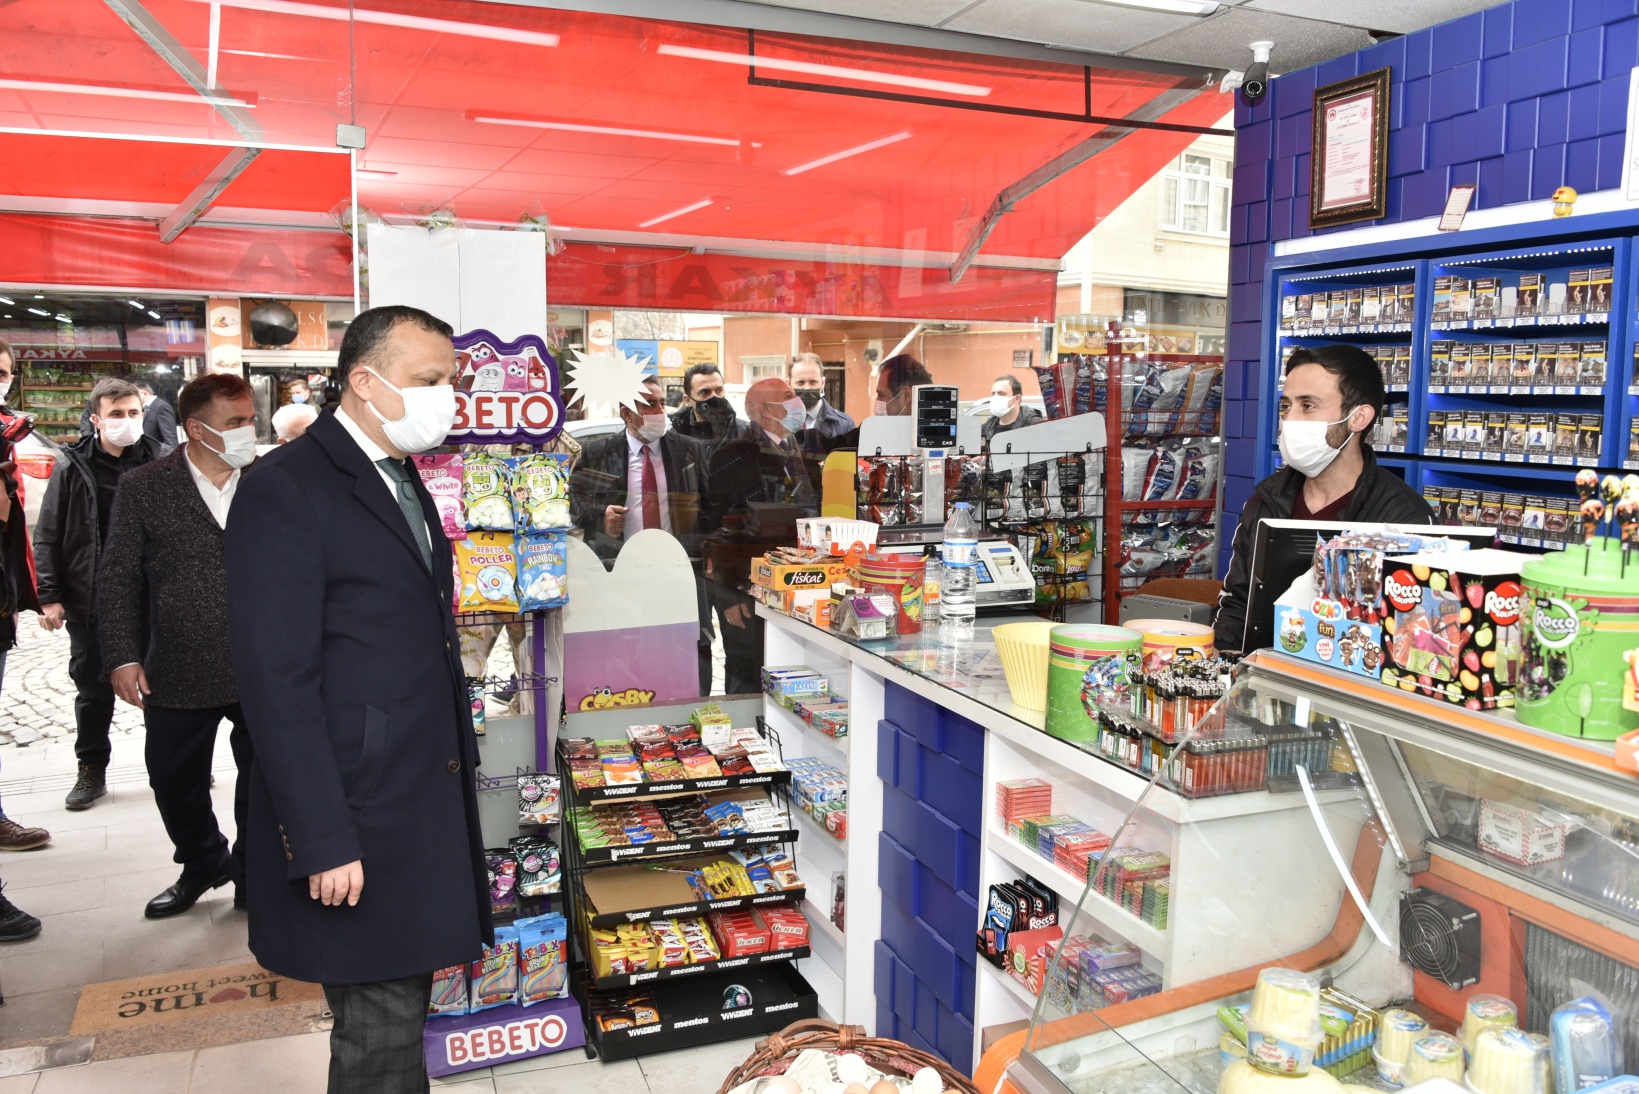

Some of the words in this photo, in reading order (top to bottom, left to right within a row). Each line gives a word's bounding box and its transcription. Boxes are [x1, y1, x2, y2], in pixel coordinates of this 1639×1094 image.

[451, 395, 554, 430] BETO
[466, 464, 495, 472] BEBETO
[472, 475, 490, 484] BEN
[434, 481, 459, 491] White
[475, 546, 505, 554] BEBETO
[528, 543, 553, 552] BEBETO
[470, 554, 514, 565] ROLLER
[527, 553, 558, 566] RAINBOW
[787, 570, 823, 588] fiskat
[1319, 623, 1334, 637] fun
[579, 687, 656, 711] COSBY
[739, 776, 772, 785] mentos
[649, 782, 684, 792] mentos
[746, 835, 779, 844] mentos
[656, 843, 691, 853] mentos
[753, 895, 786, 904] mentos
[663, 905, 698, 916] mentos
[528, 956, 545, 967] SOUR
[760, 952, 794, 962] mentos
[484, 957, 500, 969] SOUR
[526, 962, 541, 973] BELT
[481, 964, 495, 975] BELT
[670, 965, 706, 976] mentos
[121, 980, 198, 1001] home
[765, 1001, 799, 1013] mentos
[674, 1016, 709, 1029] mentos
[449, 1018, 564, 1063] BEBETO
